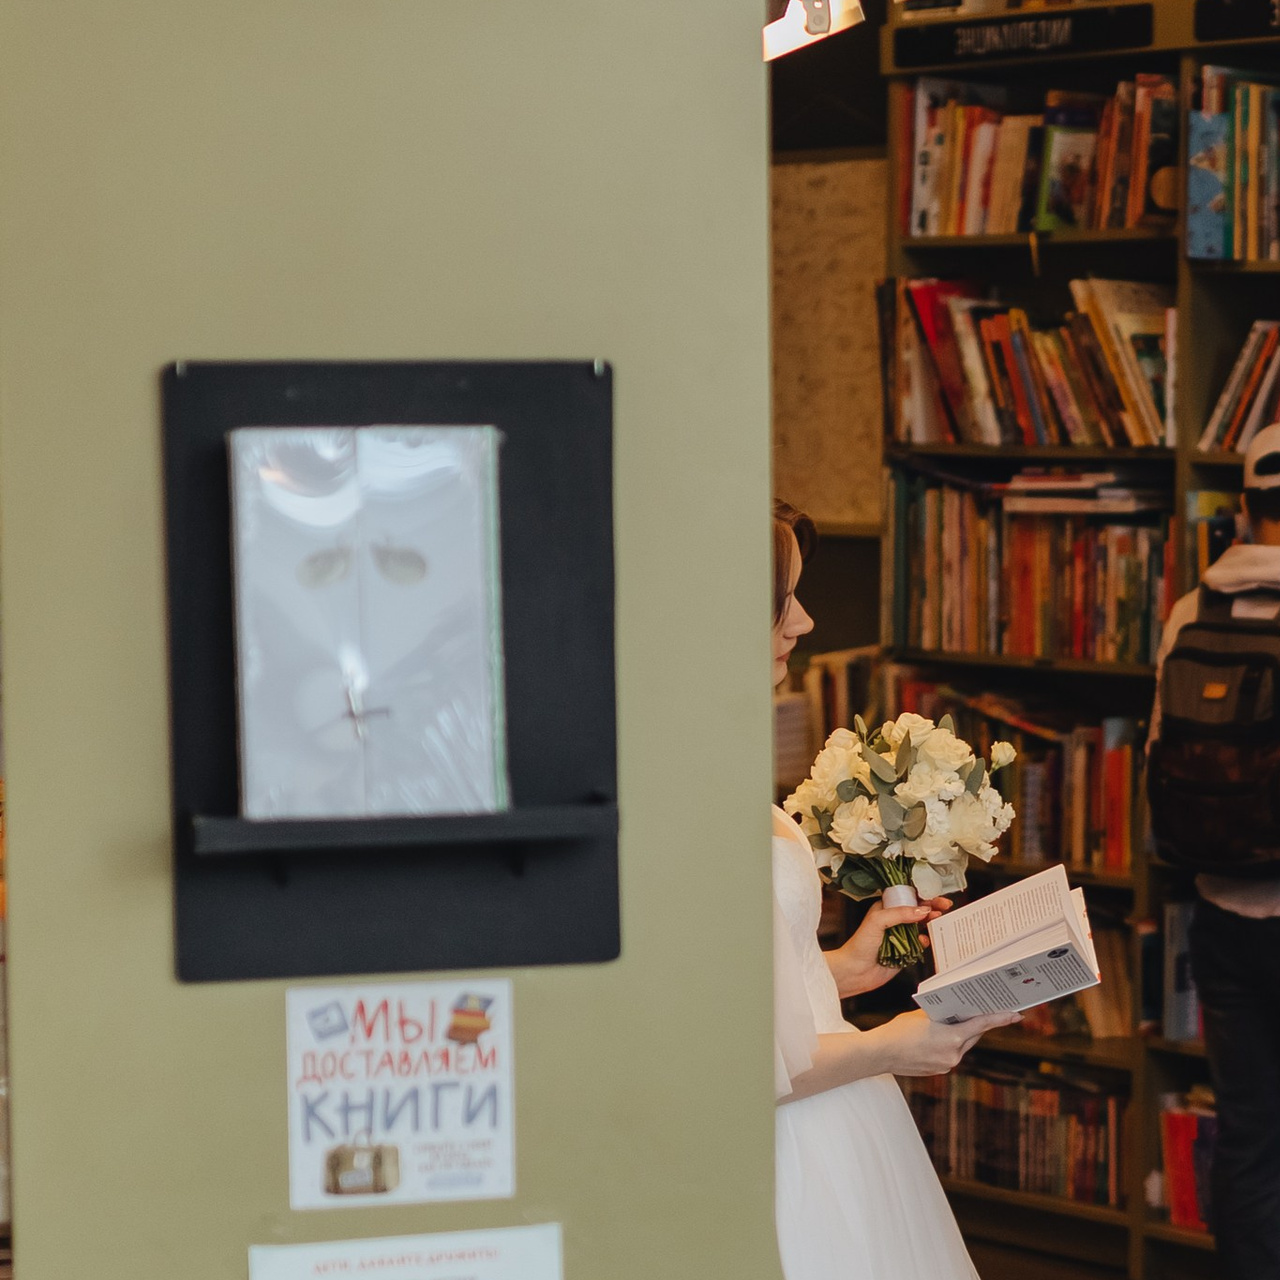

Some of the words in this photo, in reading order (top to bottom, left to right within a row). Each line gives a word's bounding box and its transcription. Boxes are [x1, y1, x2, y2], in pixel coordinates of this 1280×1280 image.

[954, 17, 1073, 55] ЭНЦИКЛОПЕДИИ
[349, 998, 437, 1045] МЫ
[296, 1047, 497, 1090] ДОСТАВЛЯЕМ
[301, 1082, 498, 1145] КНИГИ
